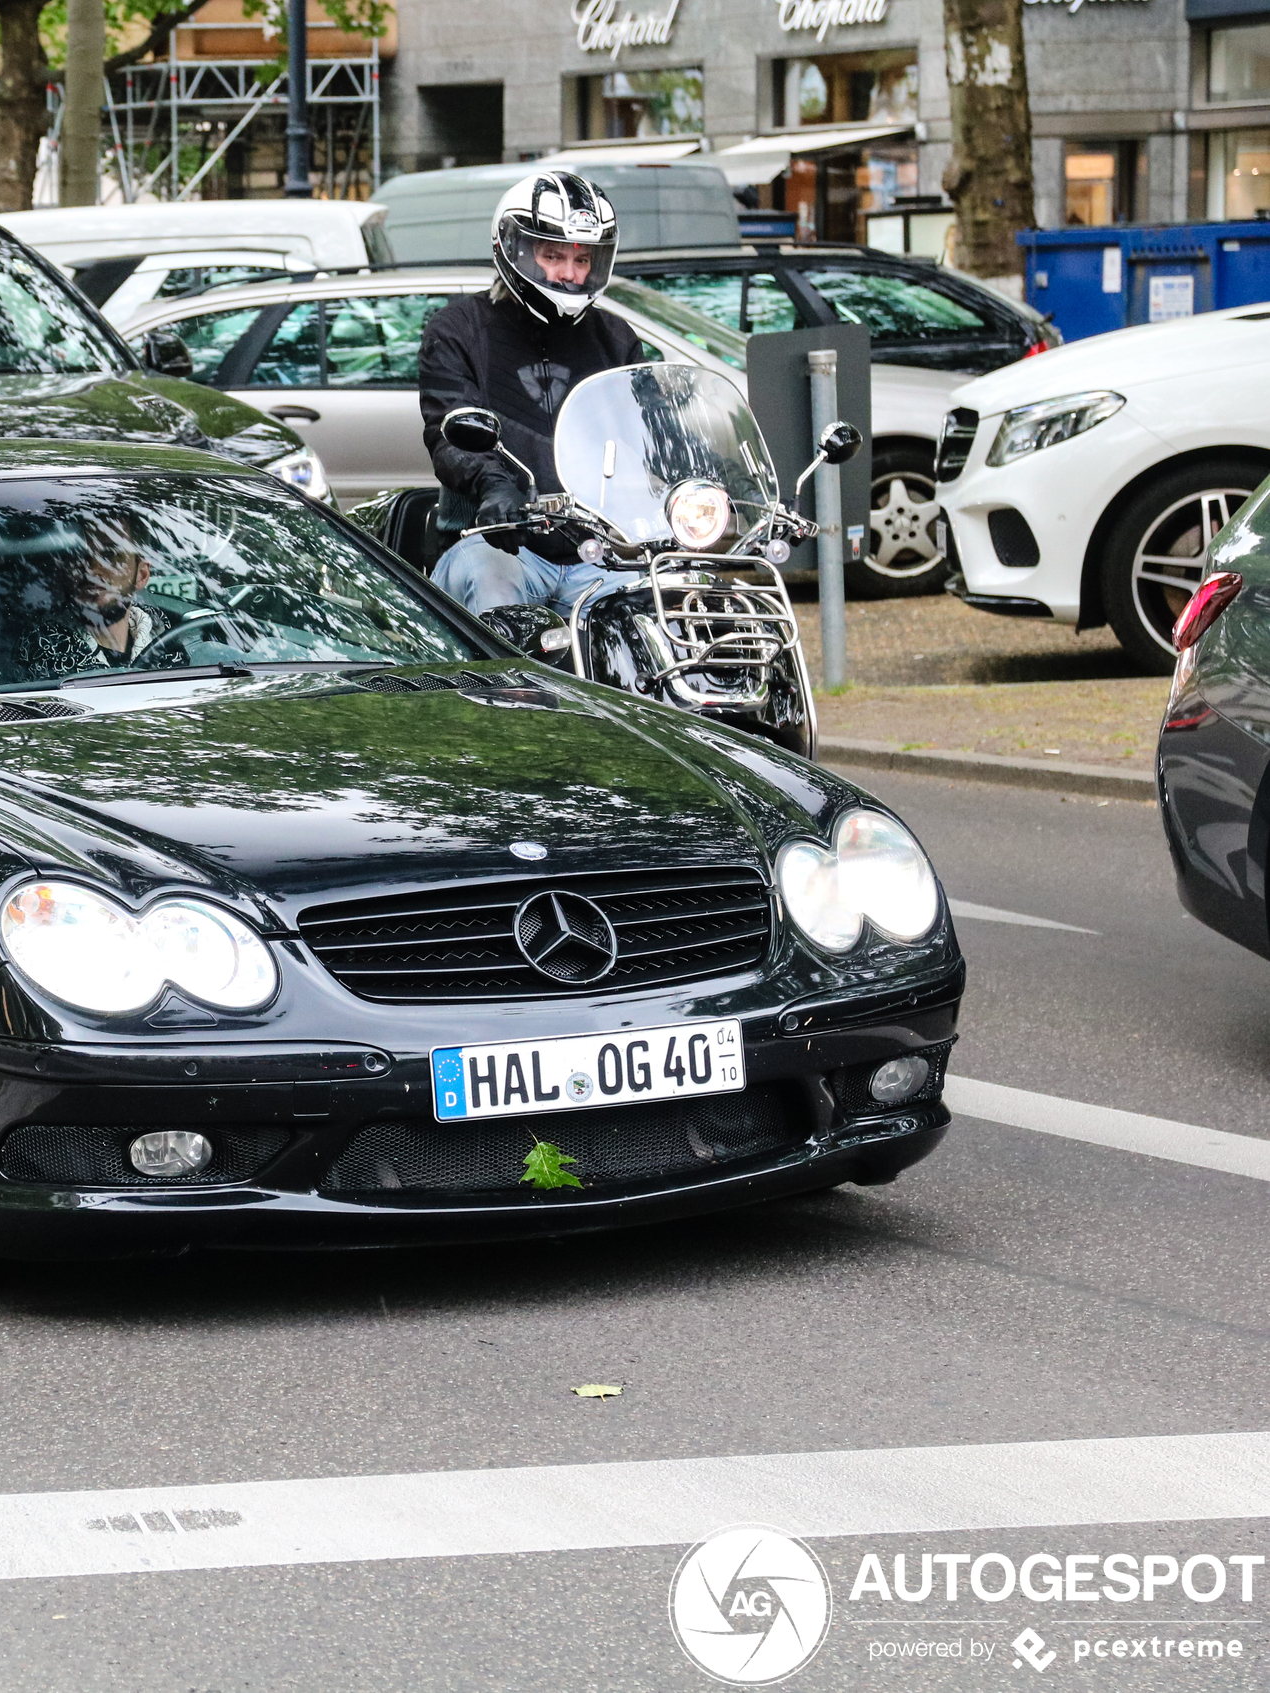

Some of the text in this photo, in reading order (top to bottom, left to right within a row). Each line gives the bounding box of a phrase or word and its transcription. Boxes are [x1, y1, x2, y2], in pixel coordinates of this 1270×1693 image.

[571, 0, 678, 61] Chopard
[716, 1028, 735, 1046] 04
[469, 1051, 560, 1108] HAL
[597, 1042, 652, 1096] OG
[663, 1033, 712, 1087] 40
[721, 1066, 738, 1083] 10
[445, 1091, 457, 1107] D
